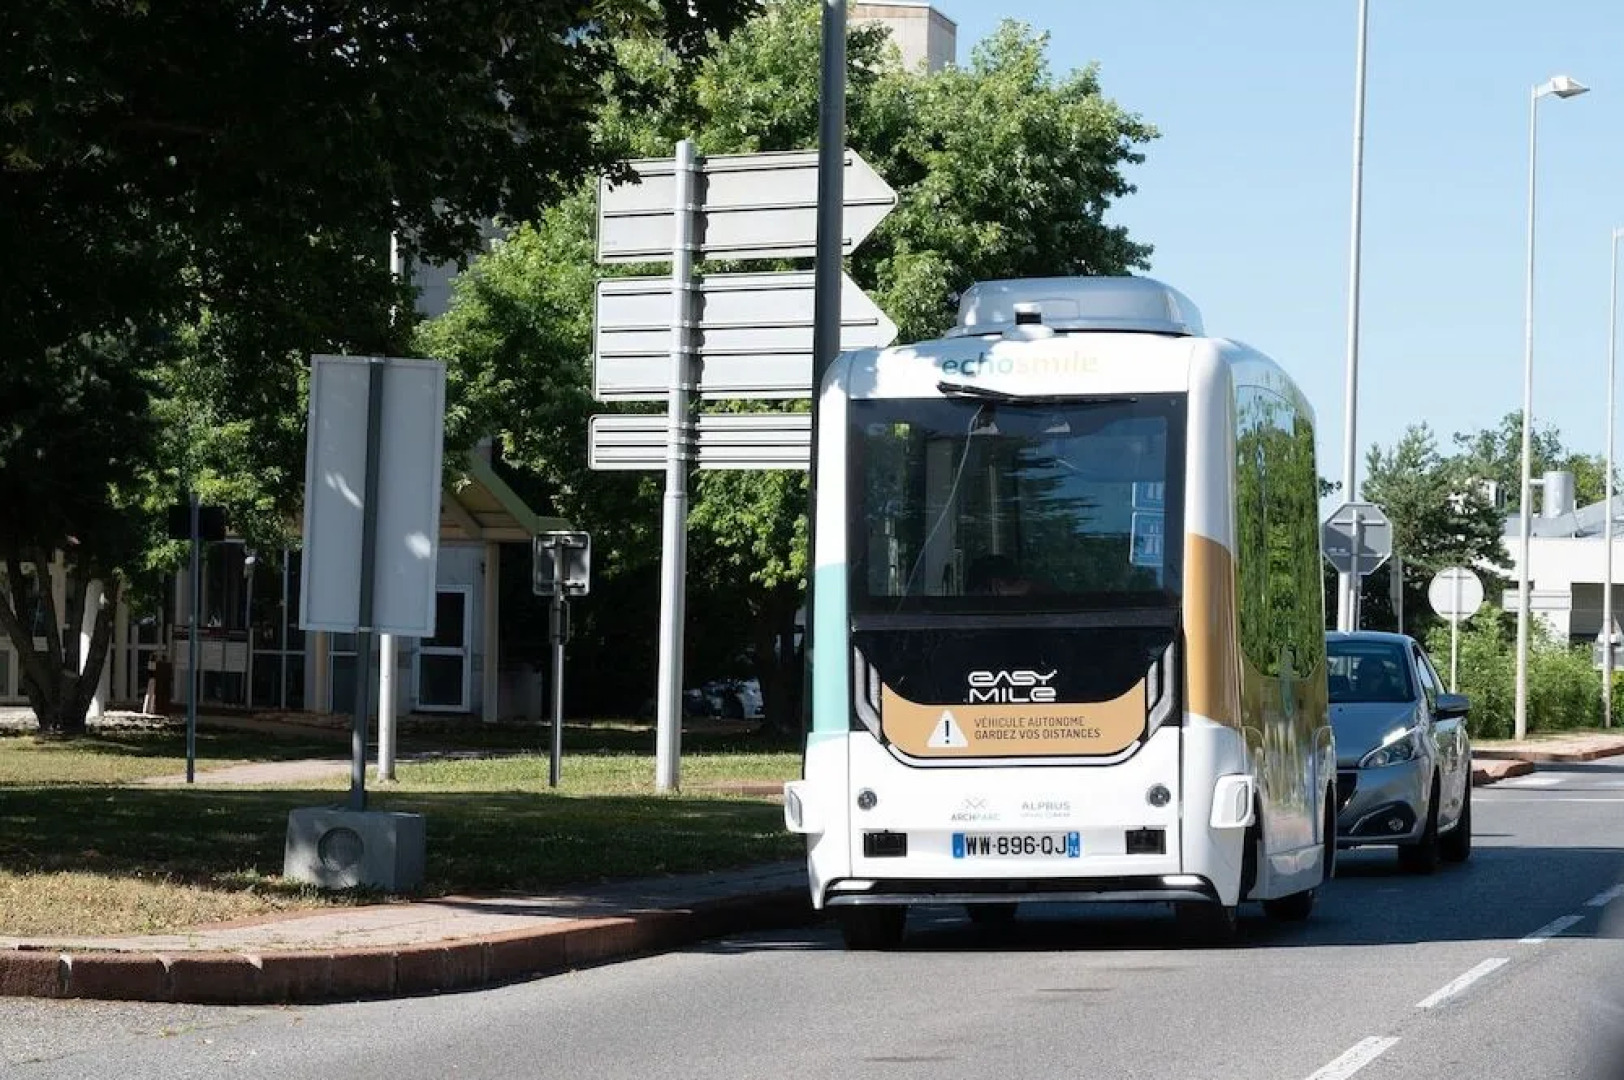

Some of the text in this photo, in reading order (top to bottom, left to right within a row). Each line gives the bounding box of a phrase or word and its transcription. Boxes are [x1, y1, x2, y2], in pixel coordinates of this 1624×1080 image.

[974, 716, 1085, 728] VÉHICULE AUTONOME
[974, 728, 1101, 740] GARDEZ VOS DISTANCES
